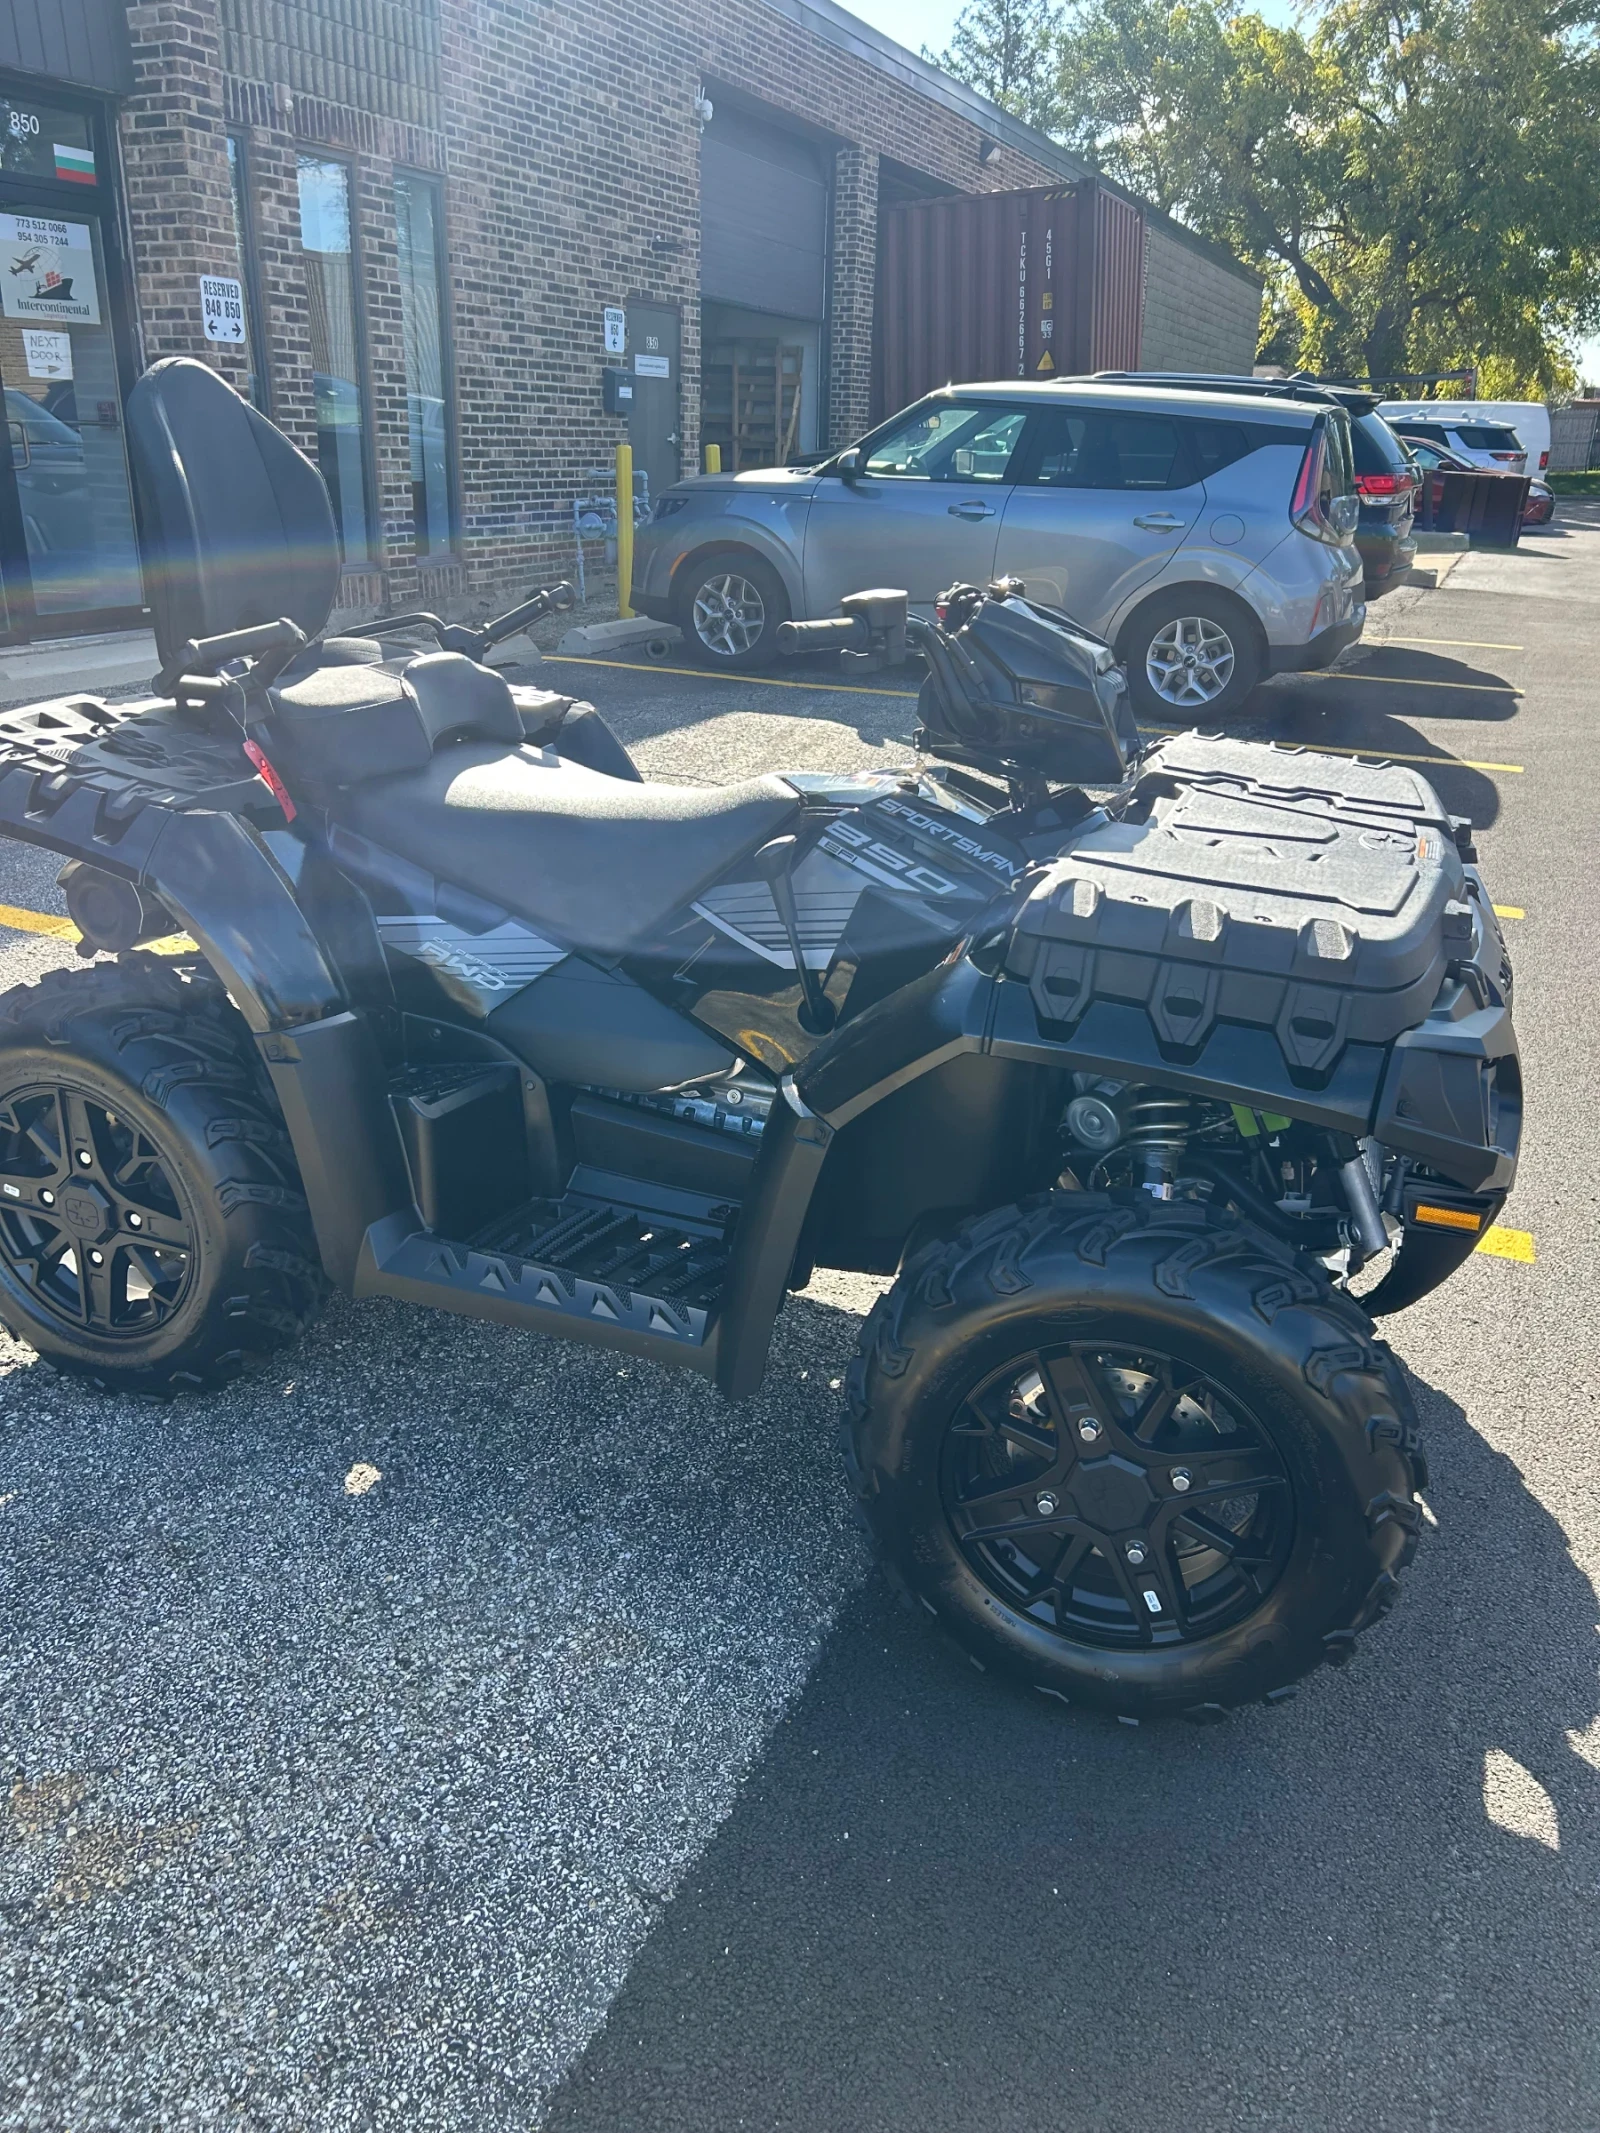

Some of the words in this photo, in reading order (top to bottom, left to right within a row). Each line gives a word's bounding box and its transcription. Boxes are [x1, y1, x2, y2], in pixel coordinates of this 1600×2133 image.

[10, 111, 40, 135] 850
[15, 218, 31, 229] 773
[32, 220, 47, 231] 512
[48, 222, 67, 234] 0066
[17, 231, 32, 242] 954
[34, 233, 49, 244] 305
[50, 235, 69, 246] 7244
[203, 280, 239, 299] RESERVED
[17, 298, 90, 316] Intercontinental
[205, 298, 221, 317] 848
[224, 300, 241, 319] 850
[30, 335, 60, 348] NEXT
[31, 350, 64, 362] DOOR
[876, 798, 1025, 877] SPORTSMAN
[824, 820, 958, 895] 850
[417, 941, 505, 991] AWD
